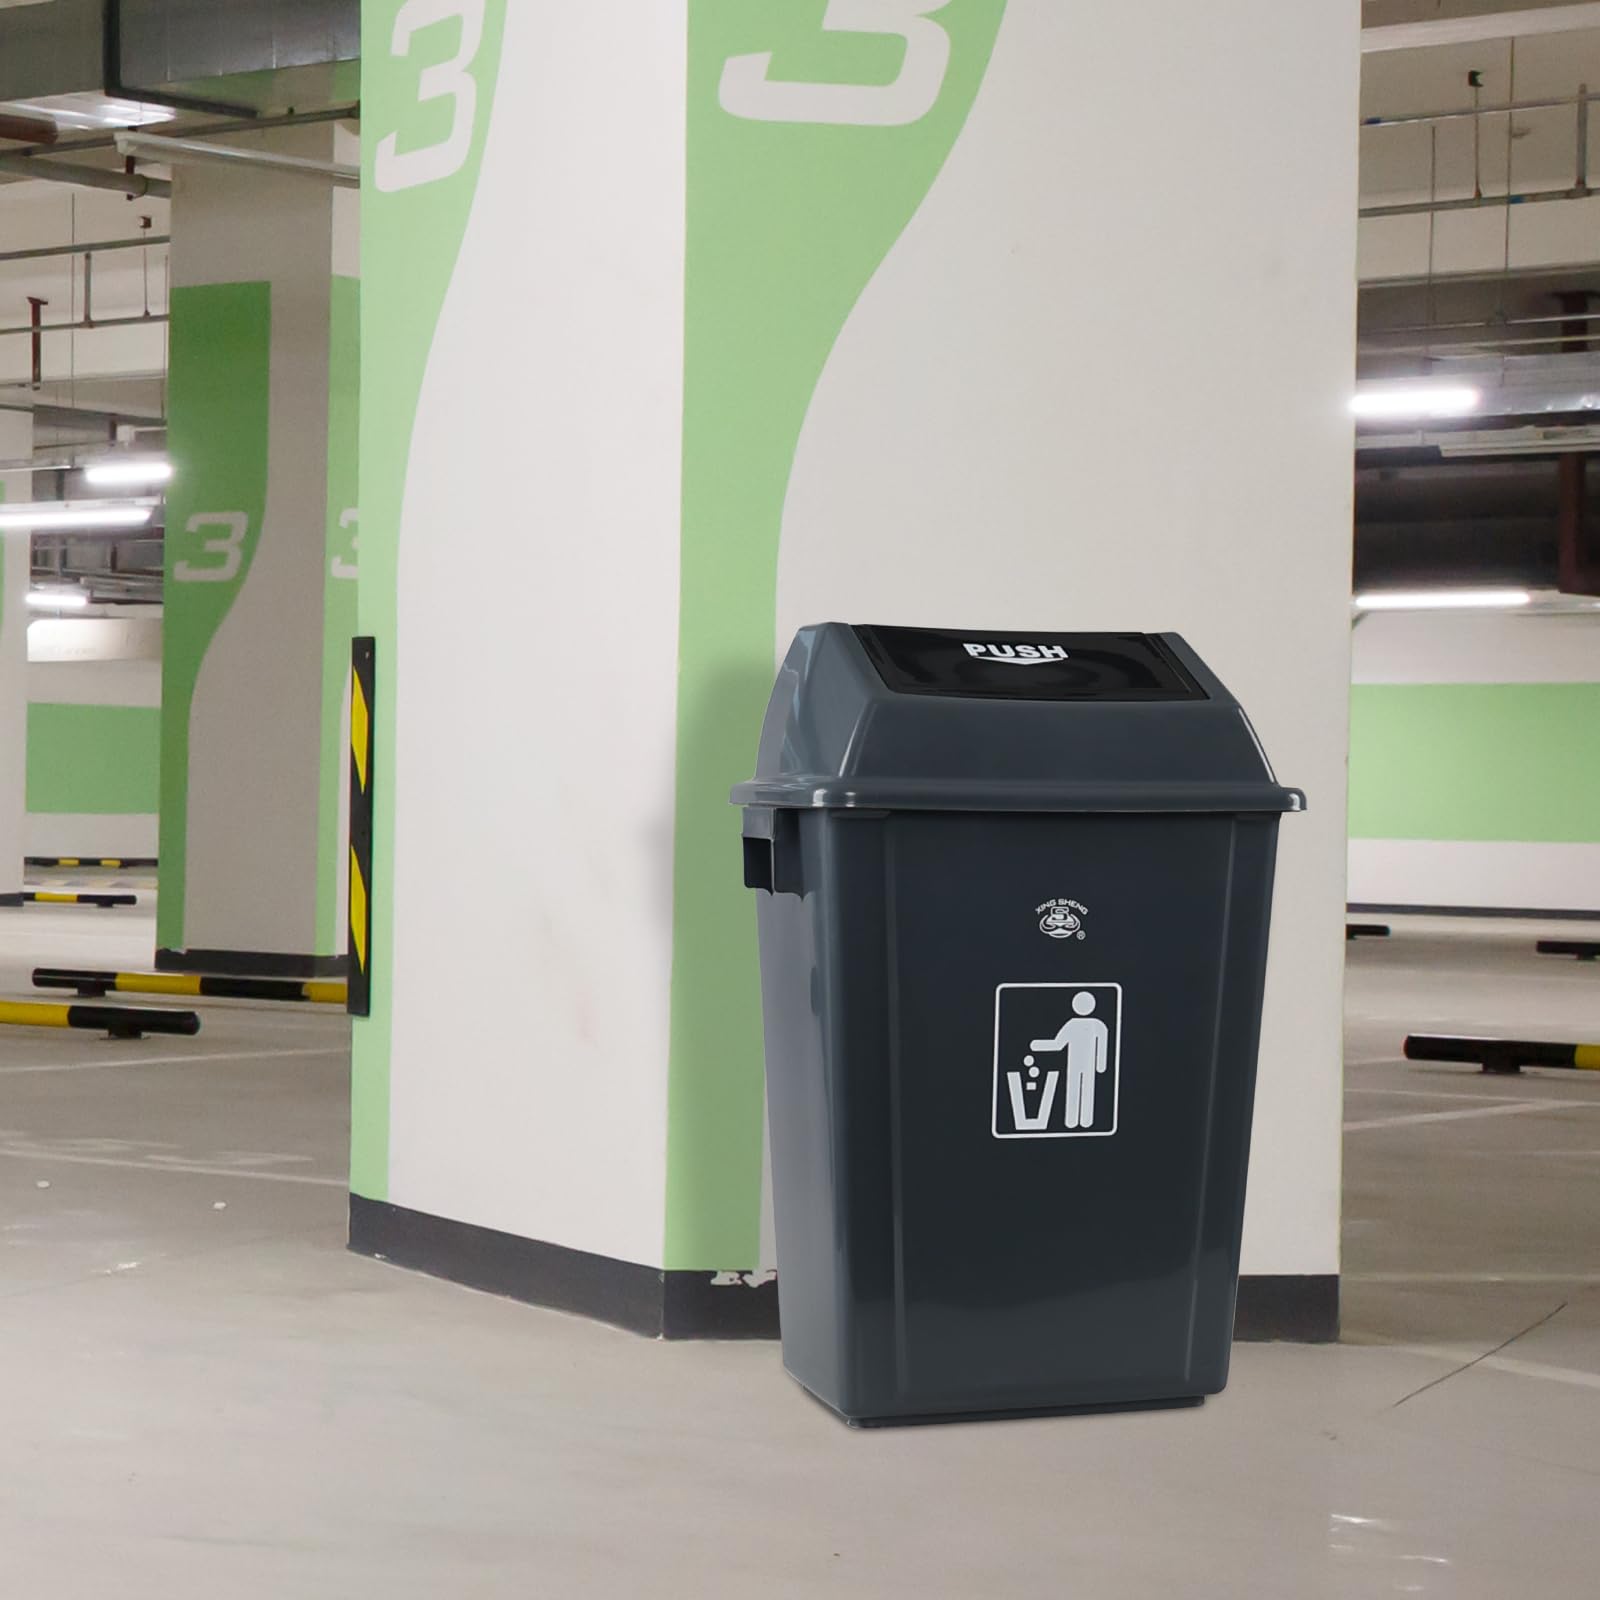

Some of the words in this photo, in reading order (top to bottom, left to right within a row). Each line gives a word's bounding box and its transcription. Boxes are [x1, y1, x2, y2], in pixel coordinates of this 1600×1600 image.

[375, 0, 484, 192] 3
[173, 511, 249, 582] 3
[962, 643, 1069, 658] PUSH
[1035, 899, 1056, 915] XING
[1058, 898, 1088, 915] SHENG
